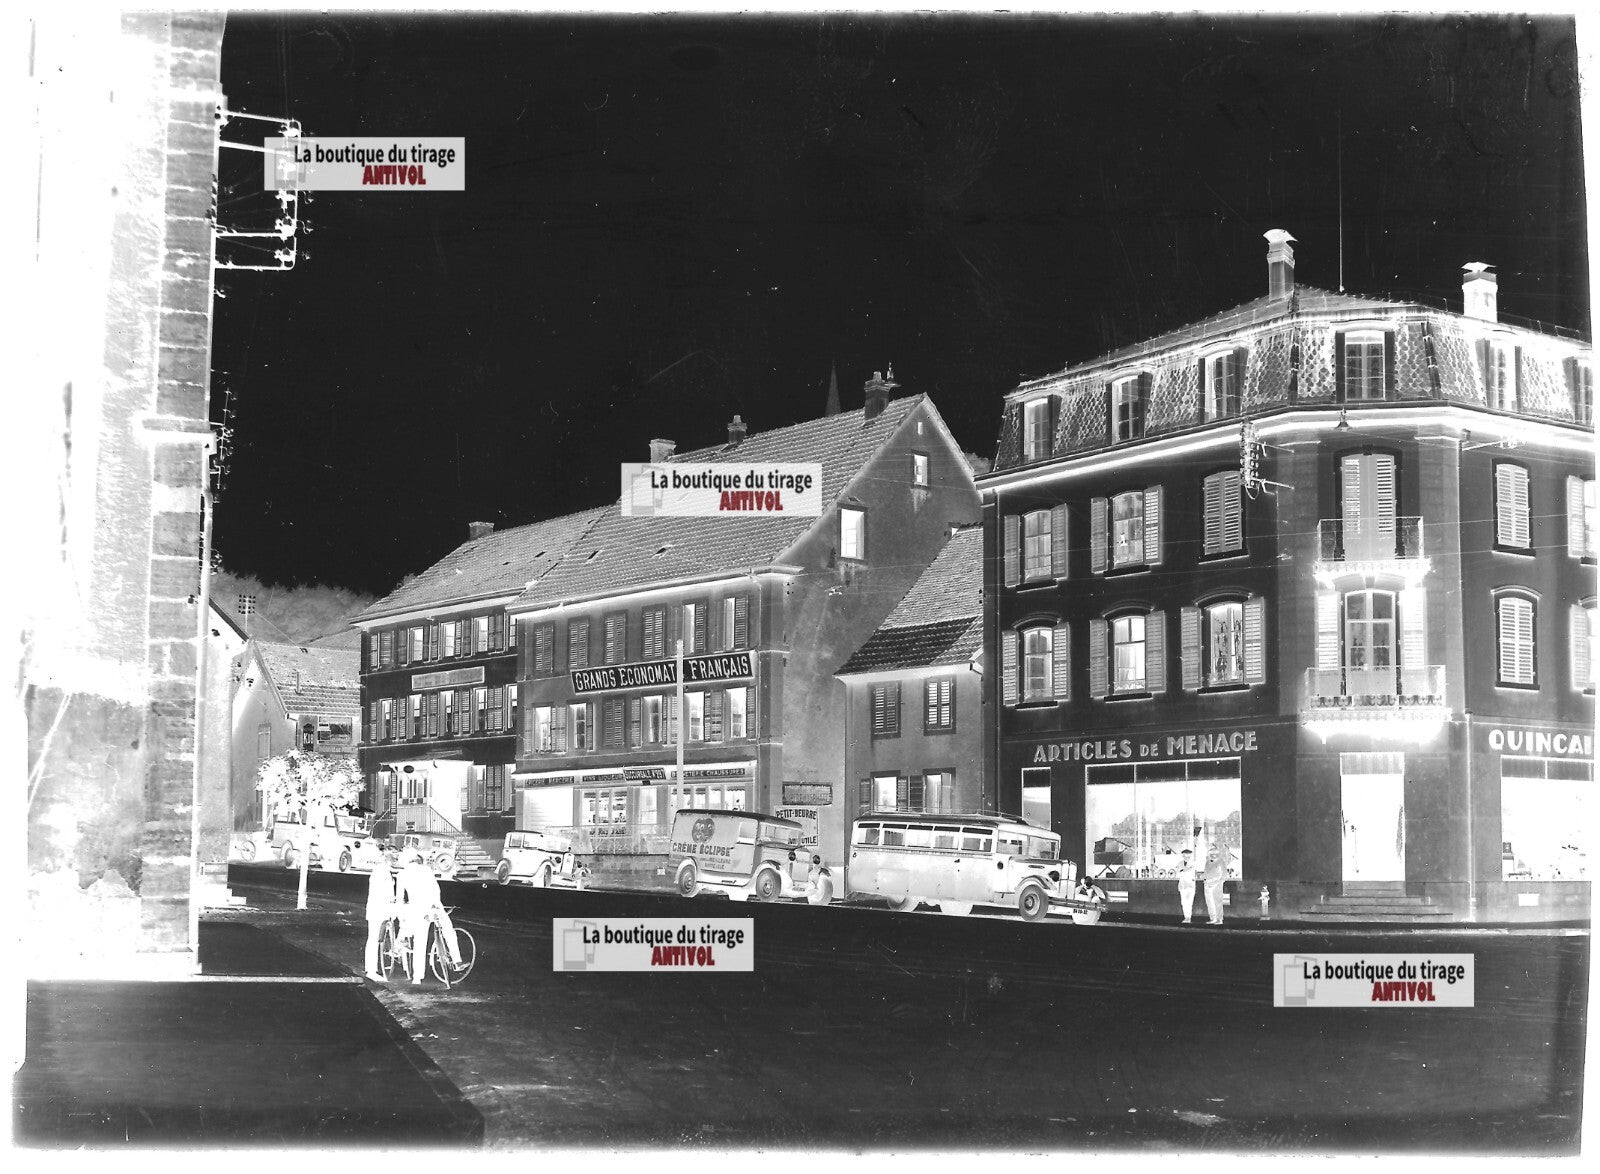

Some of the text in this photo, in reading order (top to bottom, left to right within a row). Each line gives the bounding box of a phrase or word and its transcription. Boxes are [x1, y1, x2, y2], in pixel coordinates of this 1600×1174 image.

[575, 655, 750, 691] GRANDS ECONOMAT FRANÇAIS
[1033, 730, 1258, 763] ARTICLES DE MENAGE
[1488, 729, 1592, 755] QUINCAI
[706, 768, 745, 777] CHAUSSURES
[775, 809, 818, 820] PETIT-BEURRE
